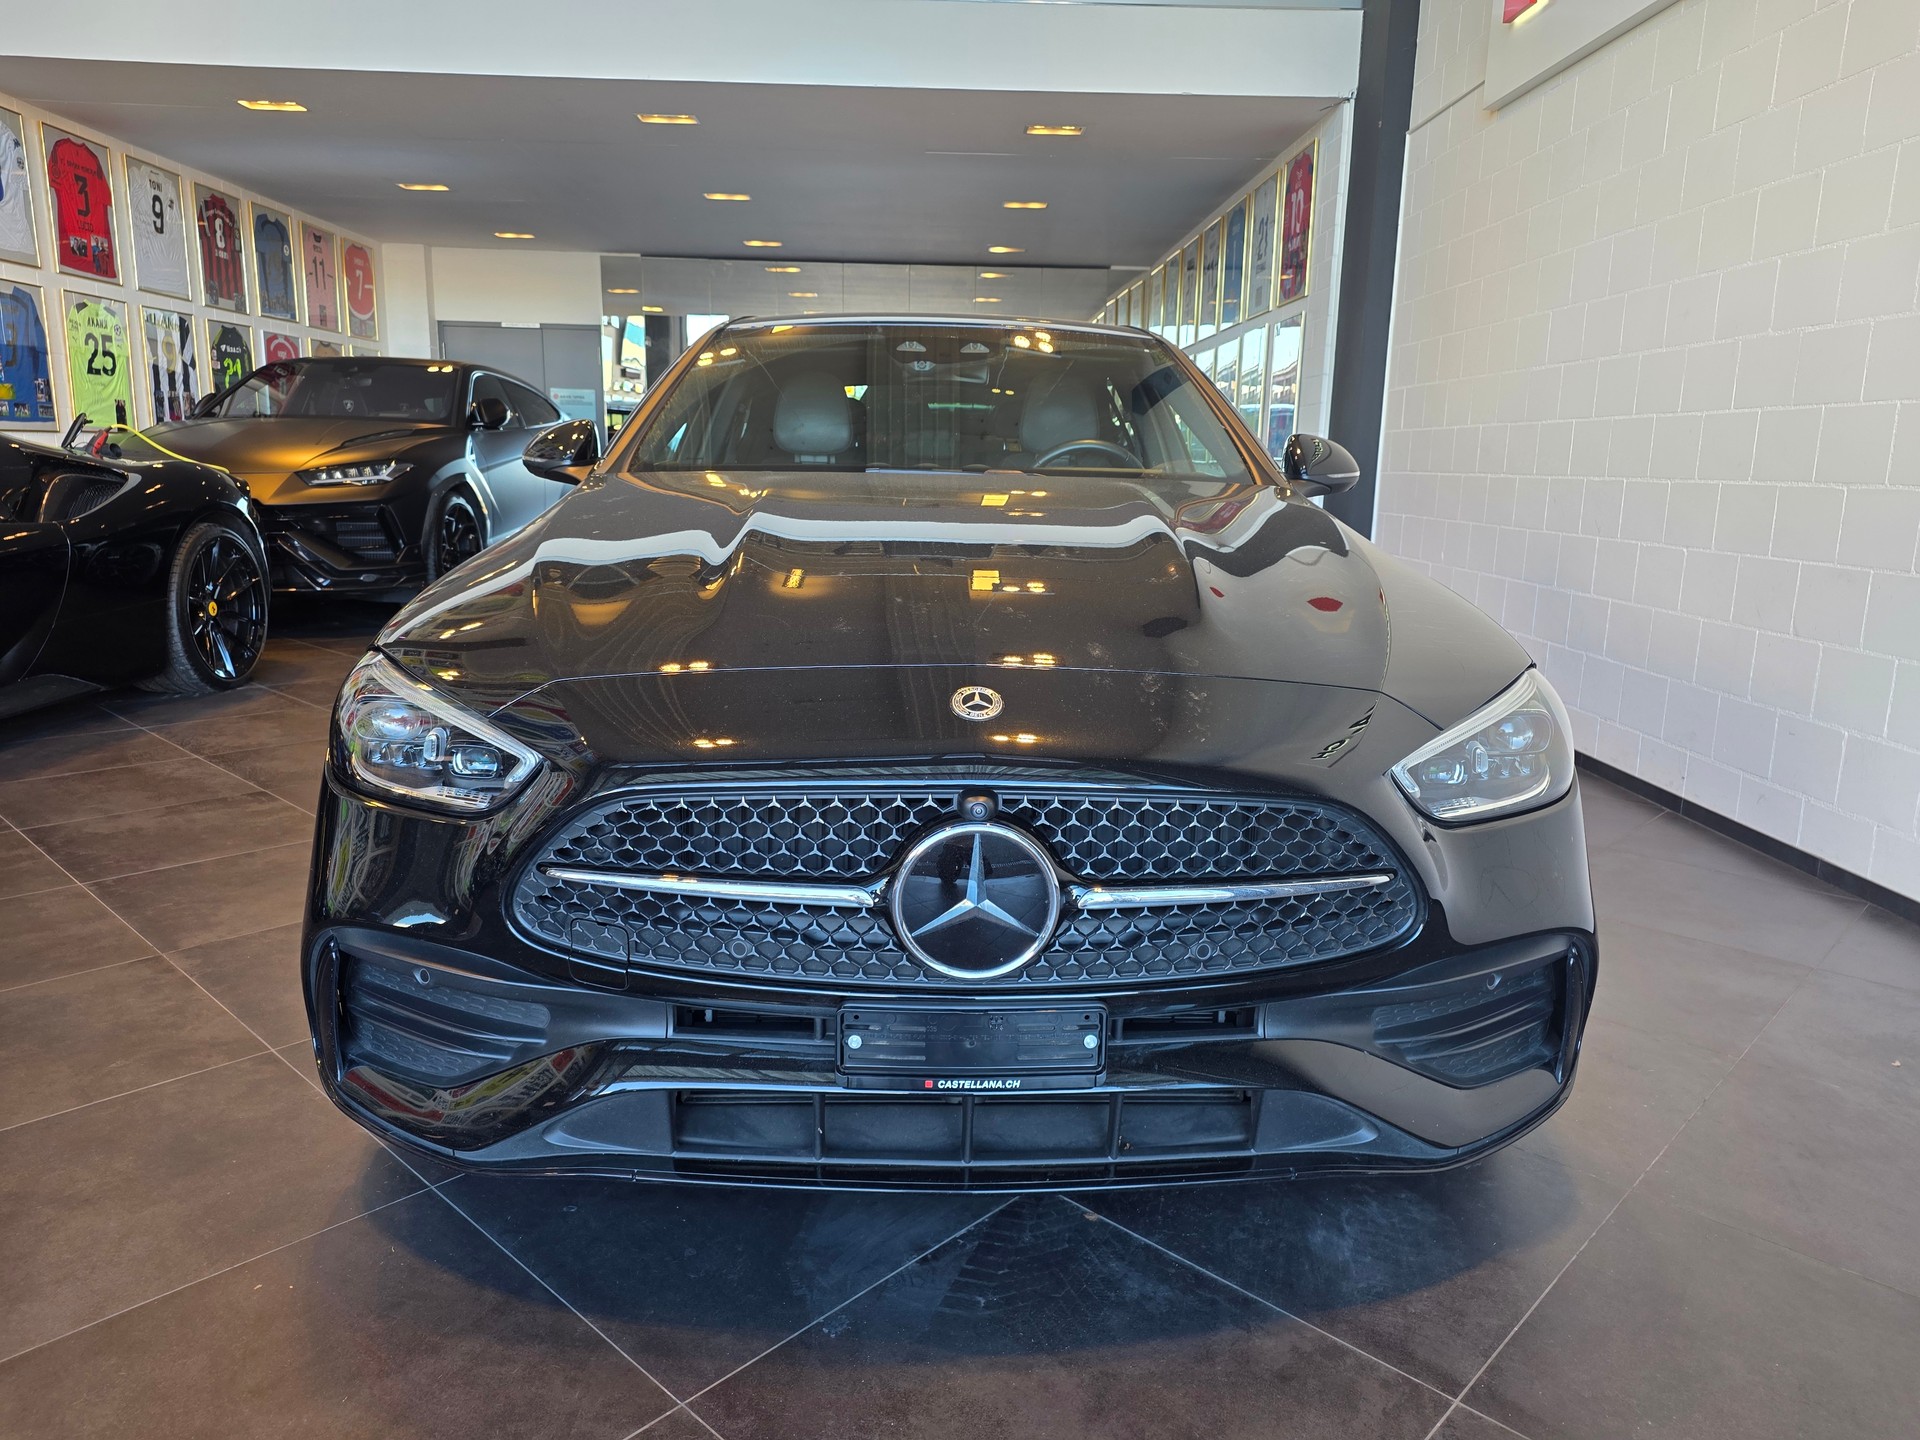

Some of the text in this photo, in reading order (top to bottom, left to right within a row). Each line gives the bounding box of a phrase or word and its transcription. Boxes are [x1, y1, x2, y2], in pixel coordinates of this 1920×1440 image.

[73, 172, 91, 218] 3
[149, 178, 163, 193] TONI
[152, 194, 165, 235] 9
[1291, 188, 1305, 236] 10
[214, 217, 226, 249] 8
[355, 269, 363, 301] 7
[84, 332, 117, 377] 25
[161, 335, 177, 374] 9
[937, 1079, 1021, 1090] CASTELLANA.CH
